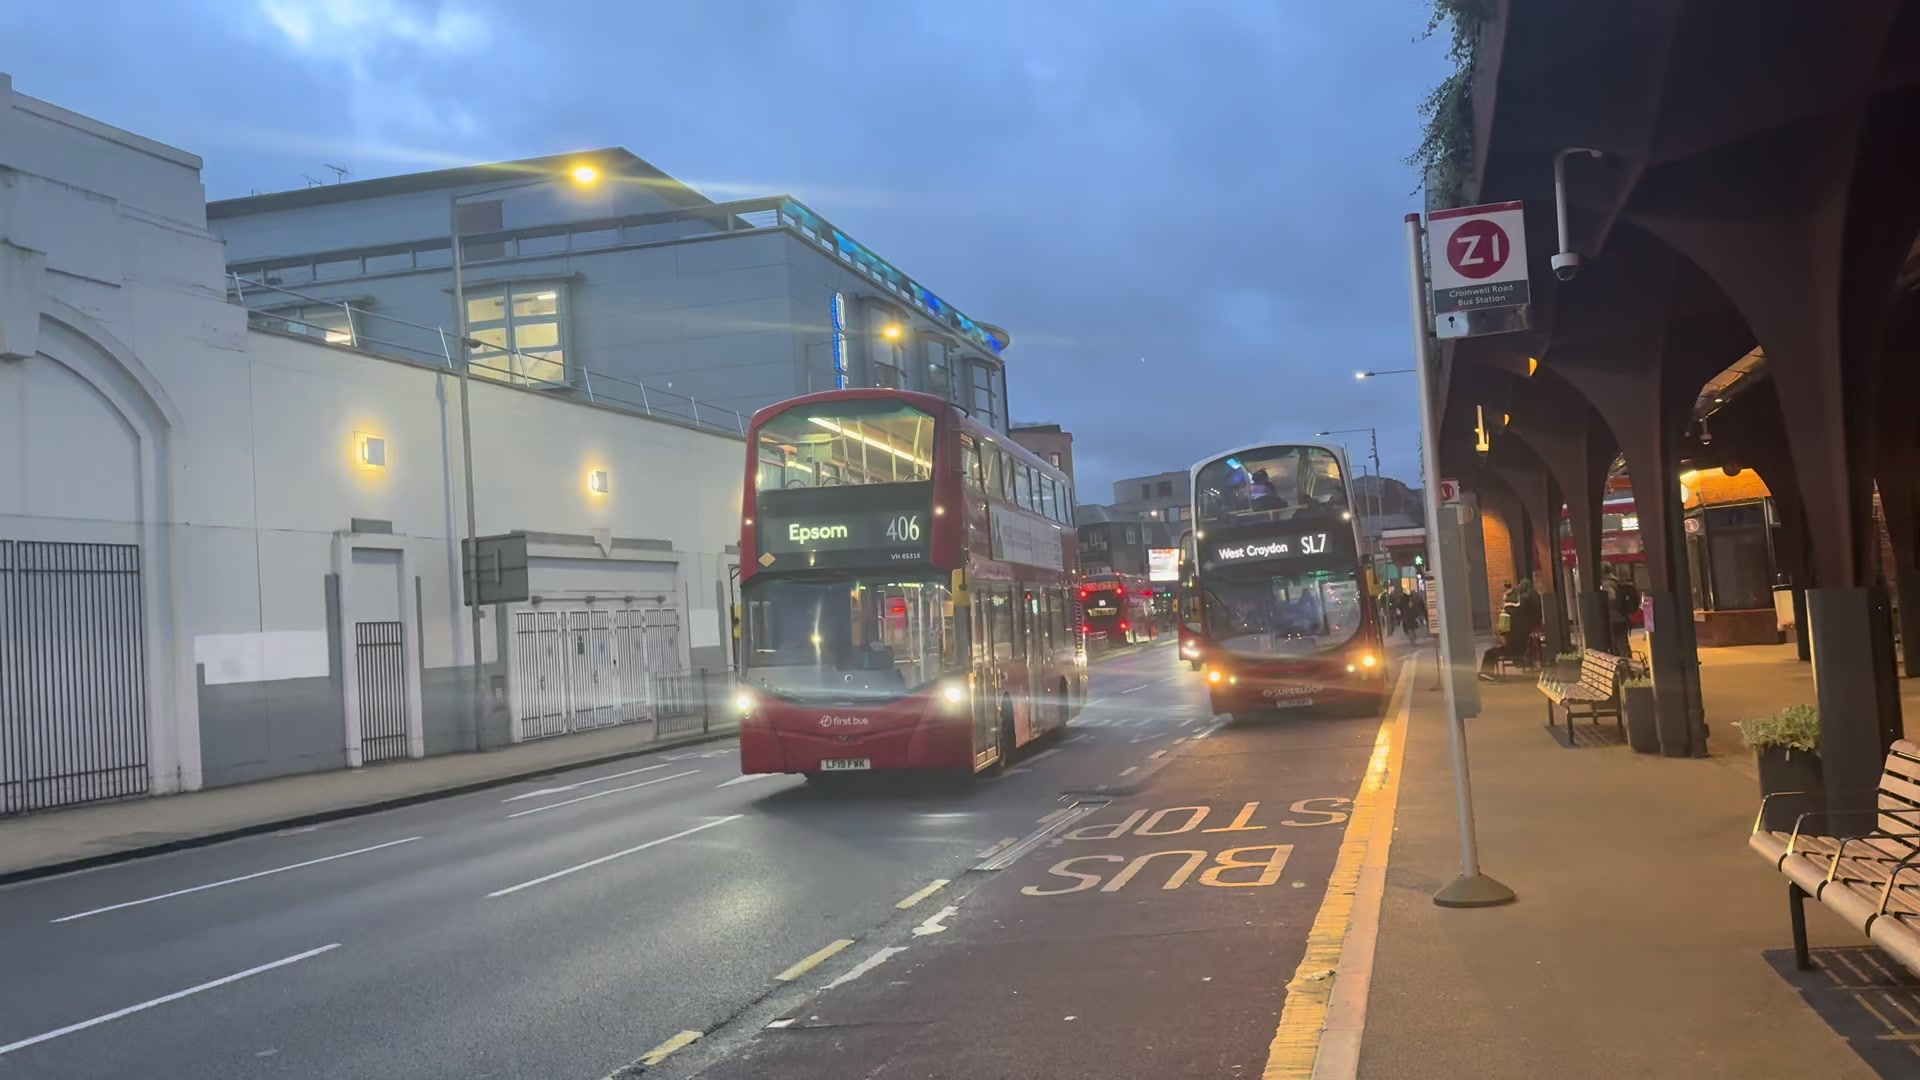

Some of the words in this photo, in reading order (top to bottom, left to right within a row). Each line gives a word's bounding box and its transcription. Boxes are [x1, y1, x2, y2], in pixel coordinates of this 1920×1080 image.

[1456, 232, 1500, 266] Z1
[1449, 286, 1490, 298] Cromwell
[1492, 284, 1514, 292] Road
[1457, 297, 1473, 306] Bus
[1475, 294, 1506, 305] Station
[788, 522, 848, 544] Epsom
[886, 515, 920, 541] 406
[1218, 546, 1244, 560] West
[1246, 542, 1288, 558] Croydon
[1300, 533, 1326, 555] SL7
[833, 716, 852, 726] first
[853, 716, 869, 725] bus
[1020, 844, 1295, 896] BUS
